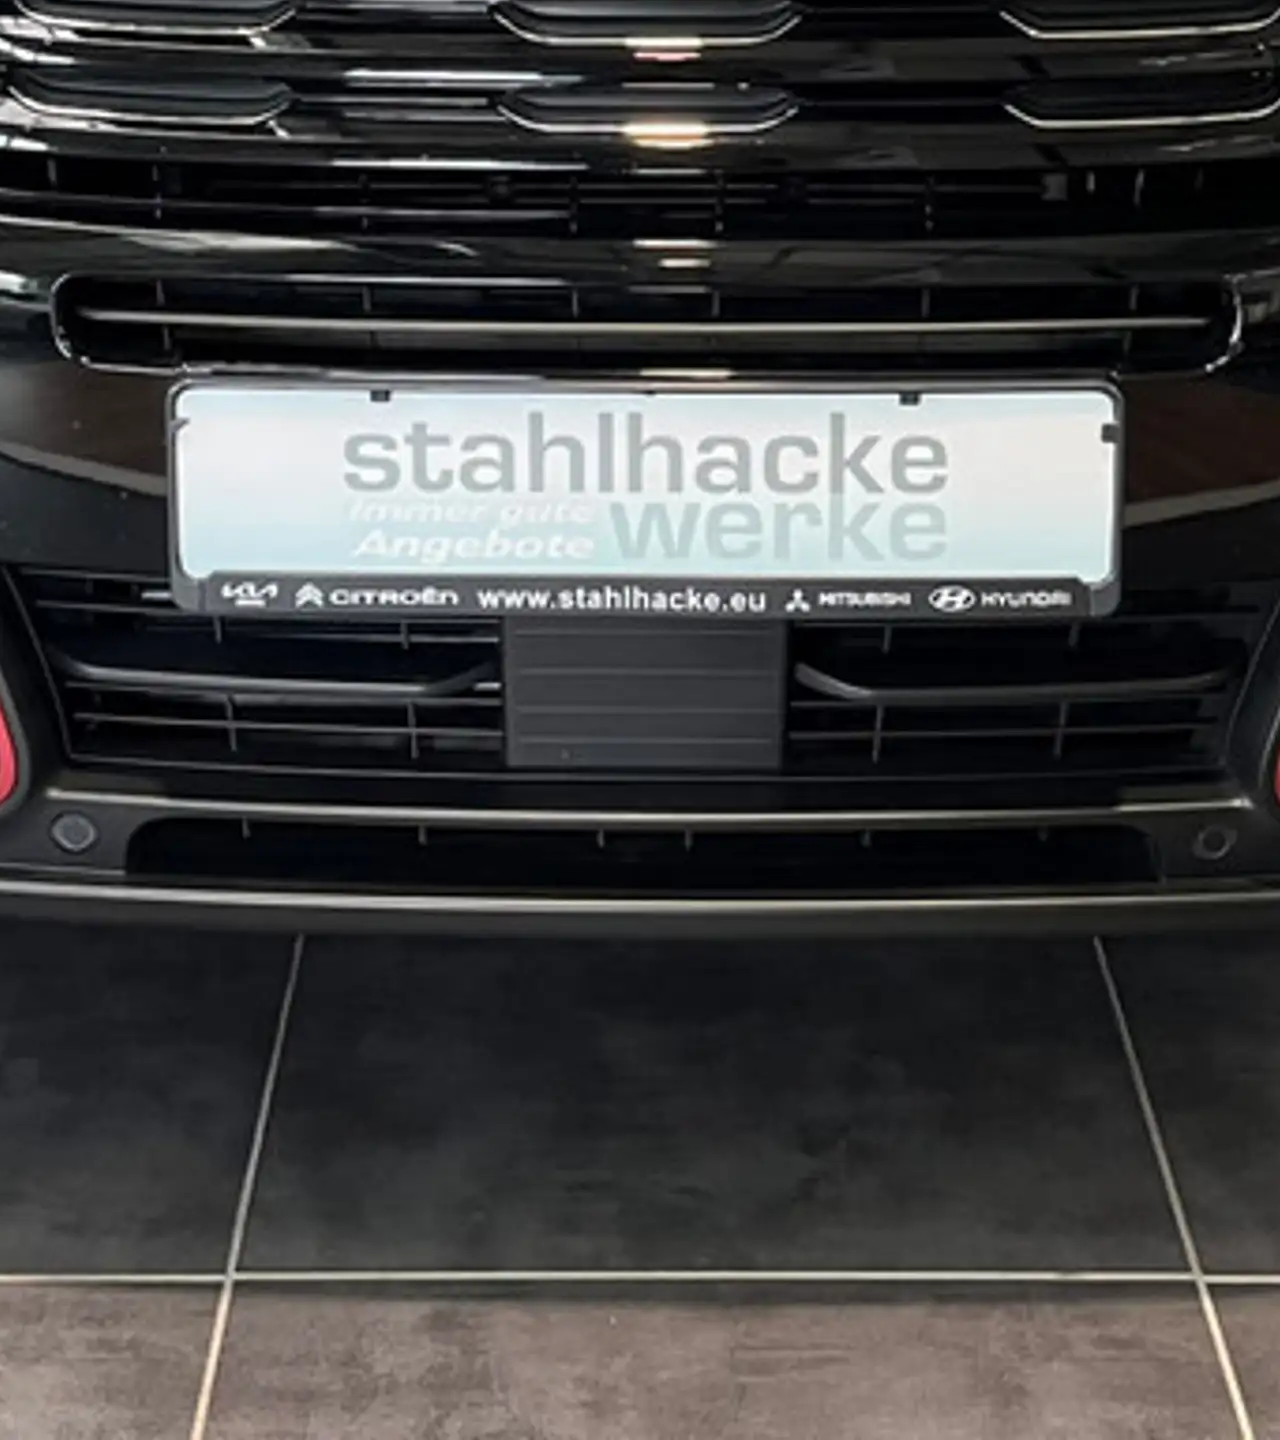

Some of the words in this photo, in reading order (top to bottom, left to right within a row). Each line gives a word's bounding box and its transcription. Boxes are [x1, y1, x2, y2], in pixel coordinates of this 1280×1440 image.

[343, 411, 949, 494] stahlhacke
[351, 527, 596, 563] Angebote
[609, 501, 948, 561] werke
[477, 585, 767, 613] www.stahlhacke.eu
